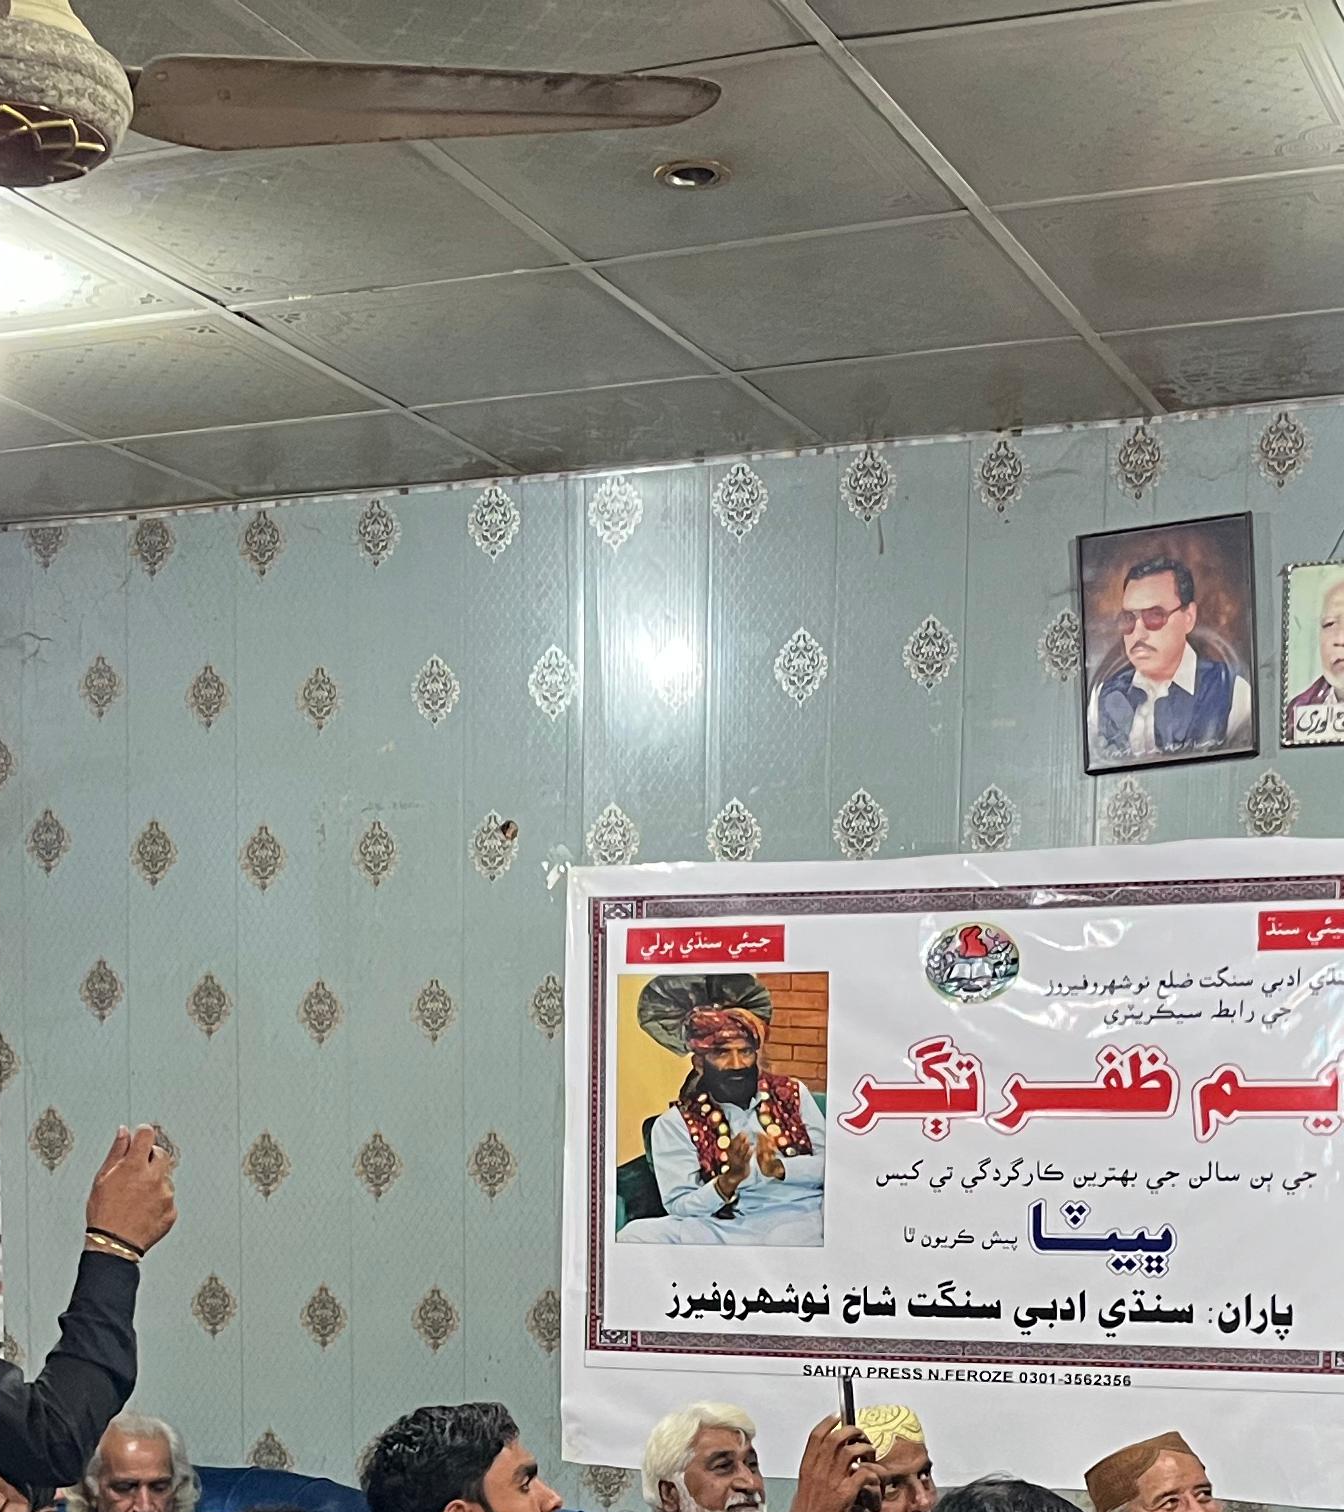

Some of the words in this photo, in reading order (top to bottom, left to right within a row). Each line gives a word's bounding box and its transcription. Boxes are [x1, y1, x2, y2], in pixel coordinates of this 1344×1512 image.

[1156, 969, 1194, 999] ضلع
[1261, 966, 1301, 998] ادبي
[989, 1048, 1176, 1132] ظفر
[842, 1284, 897, 1324] شاخ
[907, 1279, 1002, 1319] سنگت
[1013, 1289, 1086, 1336] ادبي
[1097, 1288, 1194, 1338] سنڌي
[802, 1364, 862, 1378] SAHITA
[866, 1366, 923, 1380] PRESS
[928, 1368, 1014, 1383] N.FEROZE
[1018, 1371, 1132, 1387] 0301-3562356
